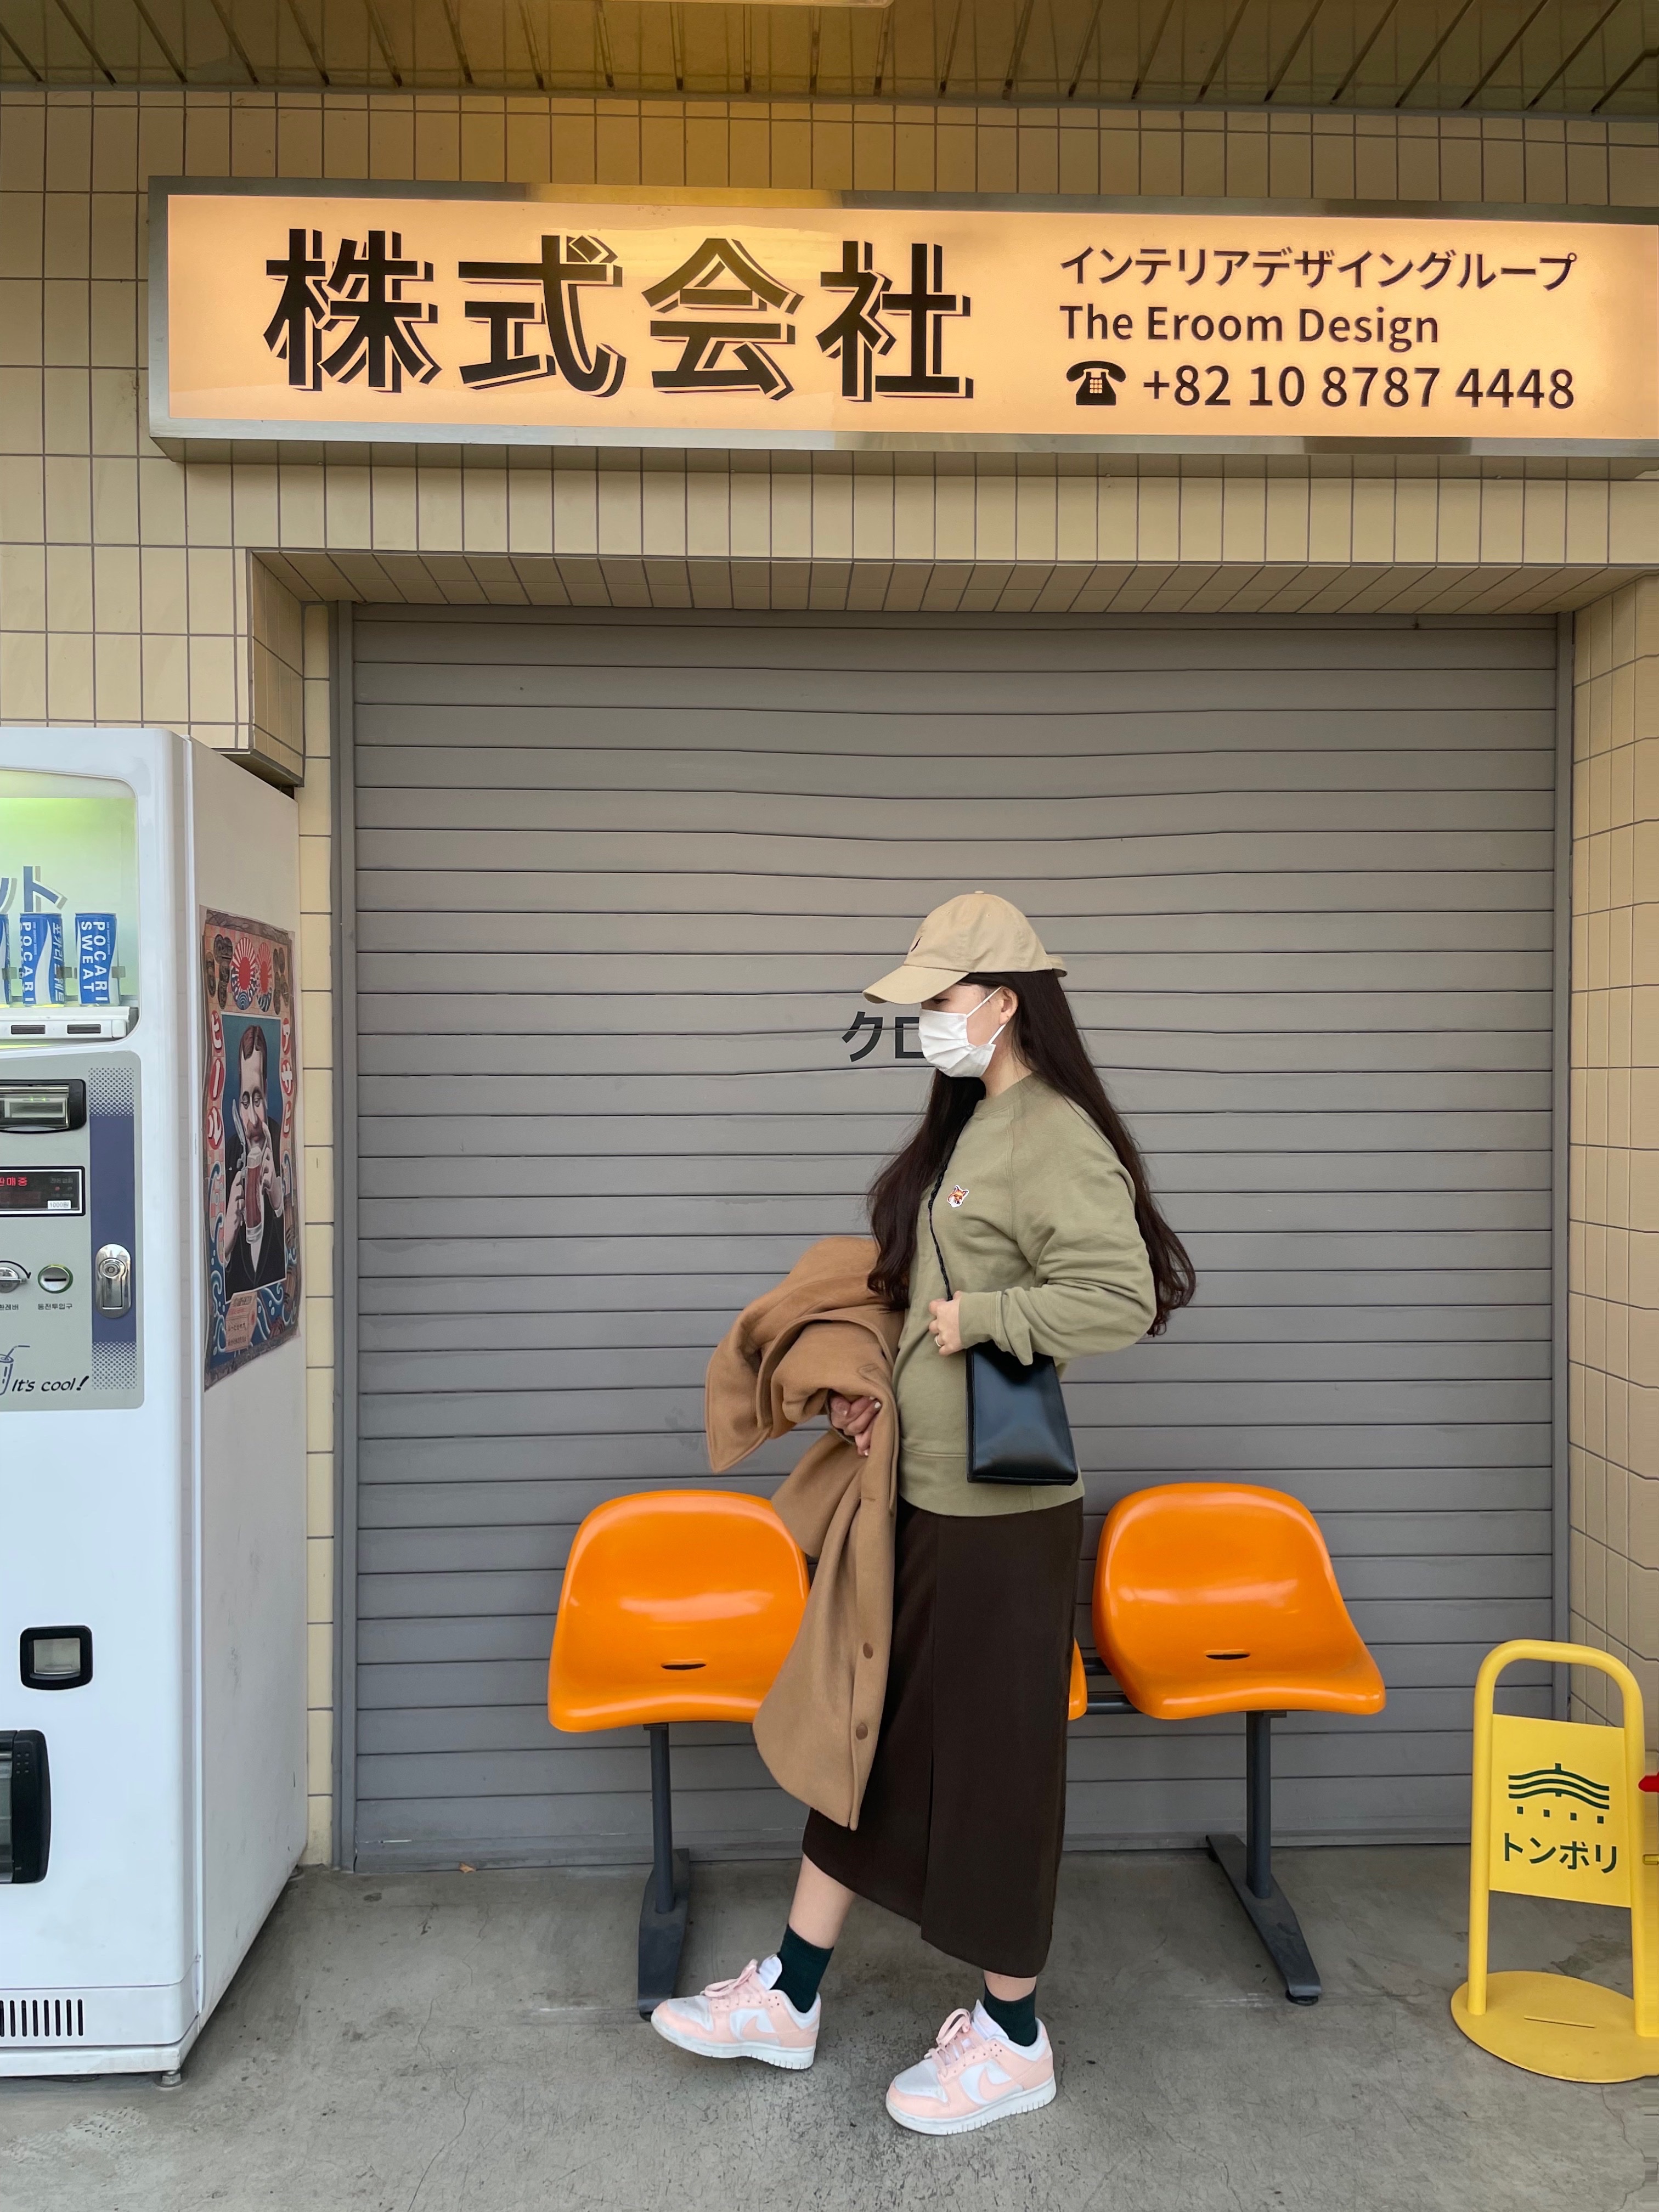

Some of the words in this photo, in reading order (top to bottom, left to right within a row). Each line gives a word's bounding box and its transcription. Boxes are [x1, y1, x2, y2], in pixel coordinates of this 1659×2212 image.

[1060, 246, 1577, 291] インテリアデザイングループ
[263, 229, 973, 402] 株式会社
[1059, 303, 1133, 340] The
[1148, 307, 1283, 341] Eroom
[1300, 306, 1437, 353] Design
[1143, 365, 1231, 406] +82
[1249, 366, 1305, 407] 10
[1322, 367, 1440, 408] 8787
[1455, 368, 1574, 409] 4448
[22, 922, 34, 1002] POCARI
[82, 921, 94, 992] SWEAT
[93, 921, 108, 1001] POCARI
[12, 1379, 36, 1392] It's
[41, 1375, 89, 1392] cool!
